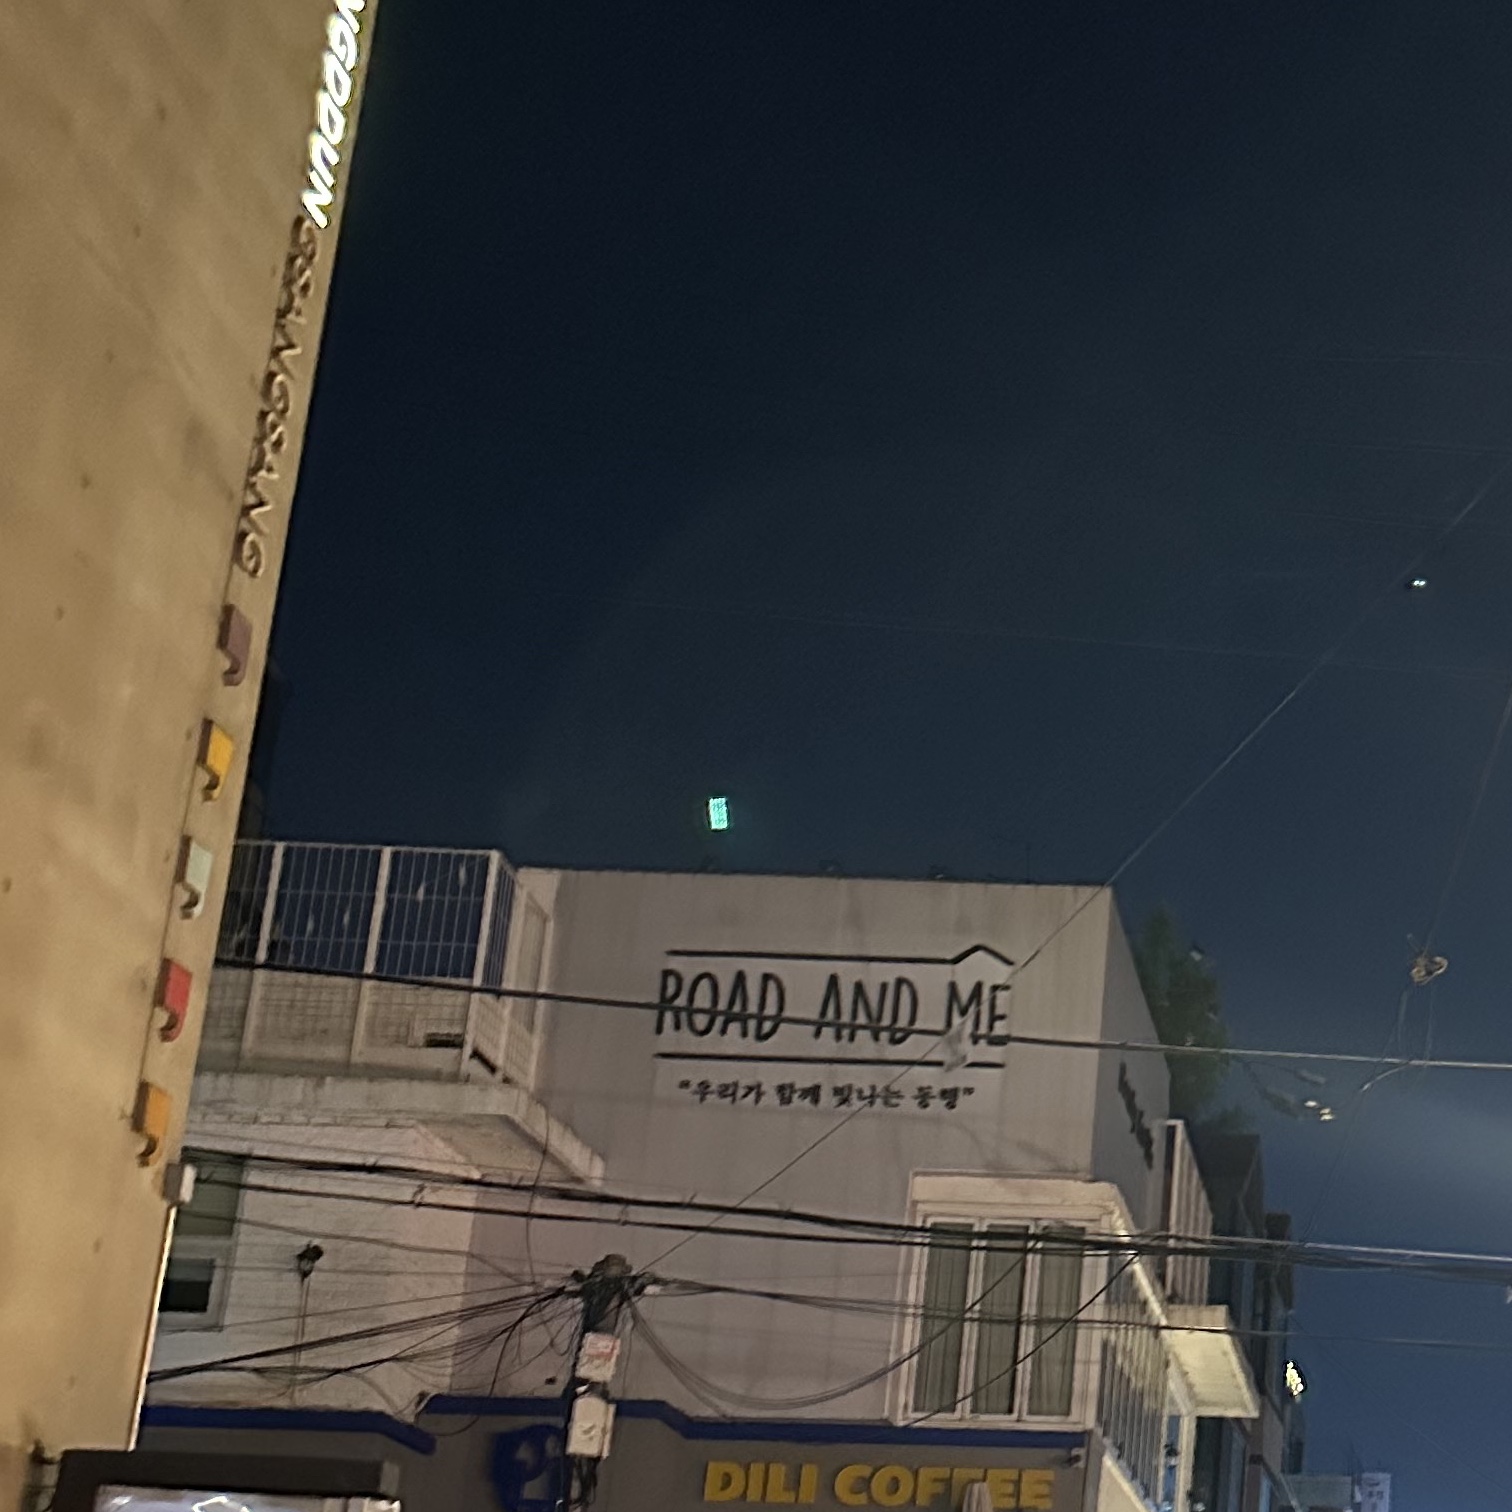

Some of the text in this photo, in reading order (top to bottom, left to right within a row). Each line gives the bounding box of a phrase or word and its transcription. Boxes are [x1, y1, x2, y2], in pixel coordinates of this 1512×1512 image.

[655, 968, 1012, 1047] ROAD AND ME
[775, 1080, 822, 1107] 함께
[703, 1460, 1055, 1510] DILI COFFEE
